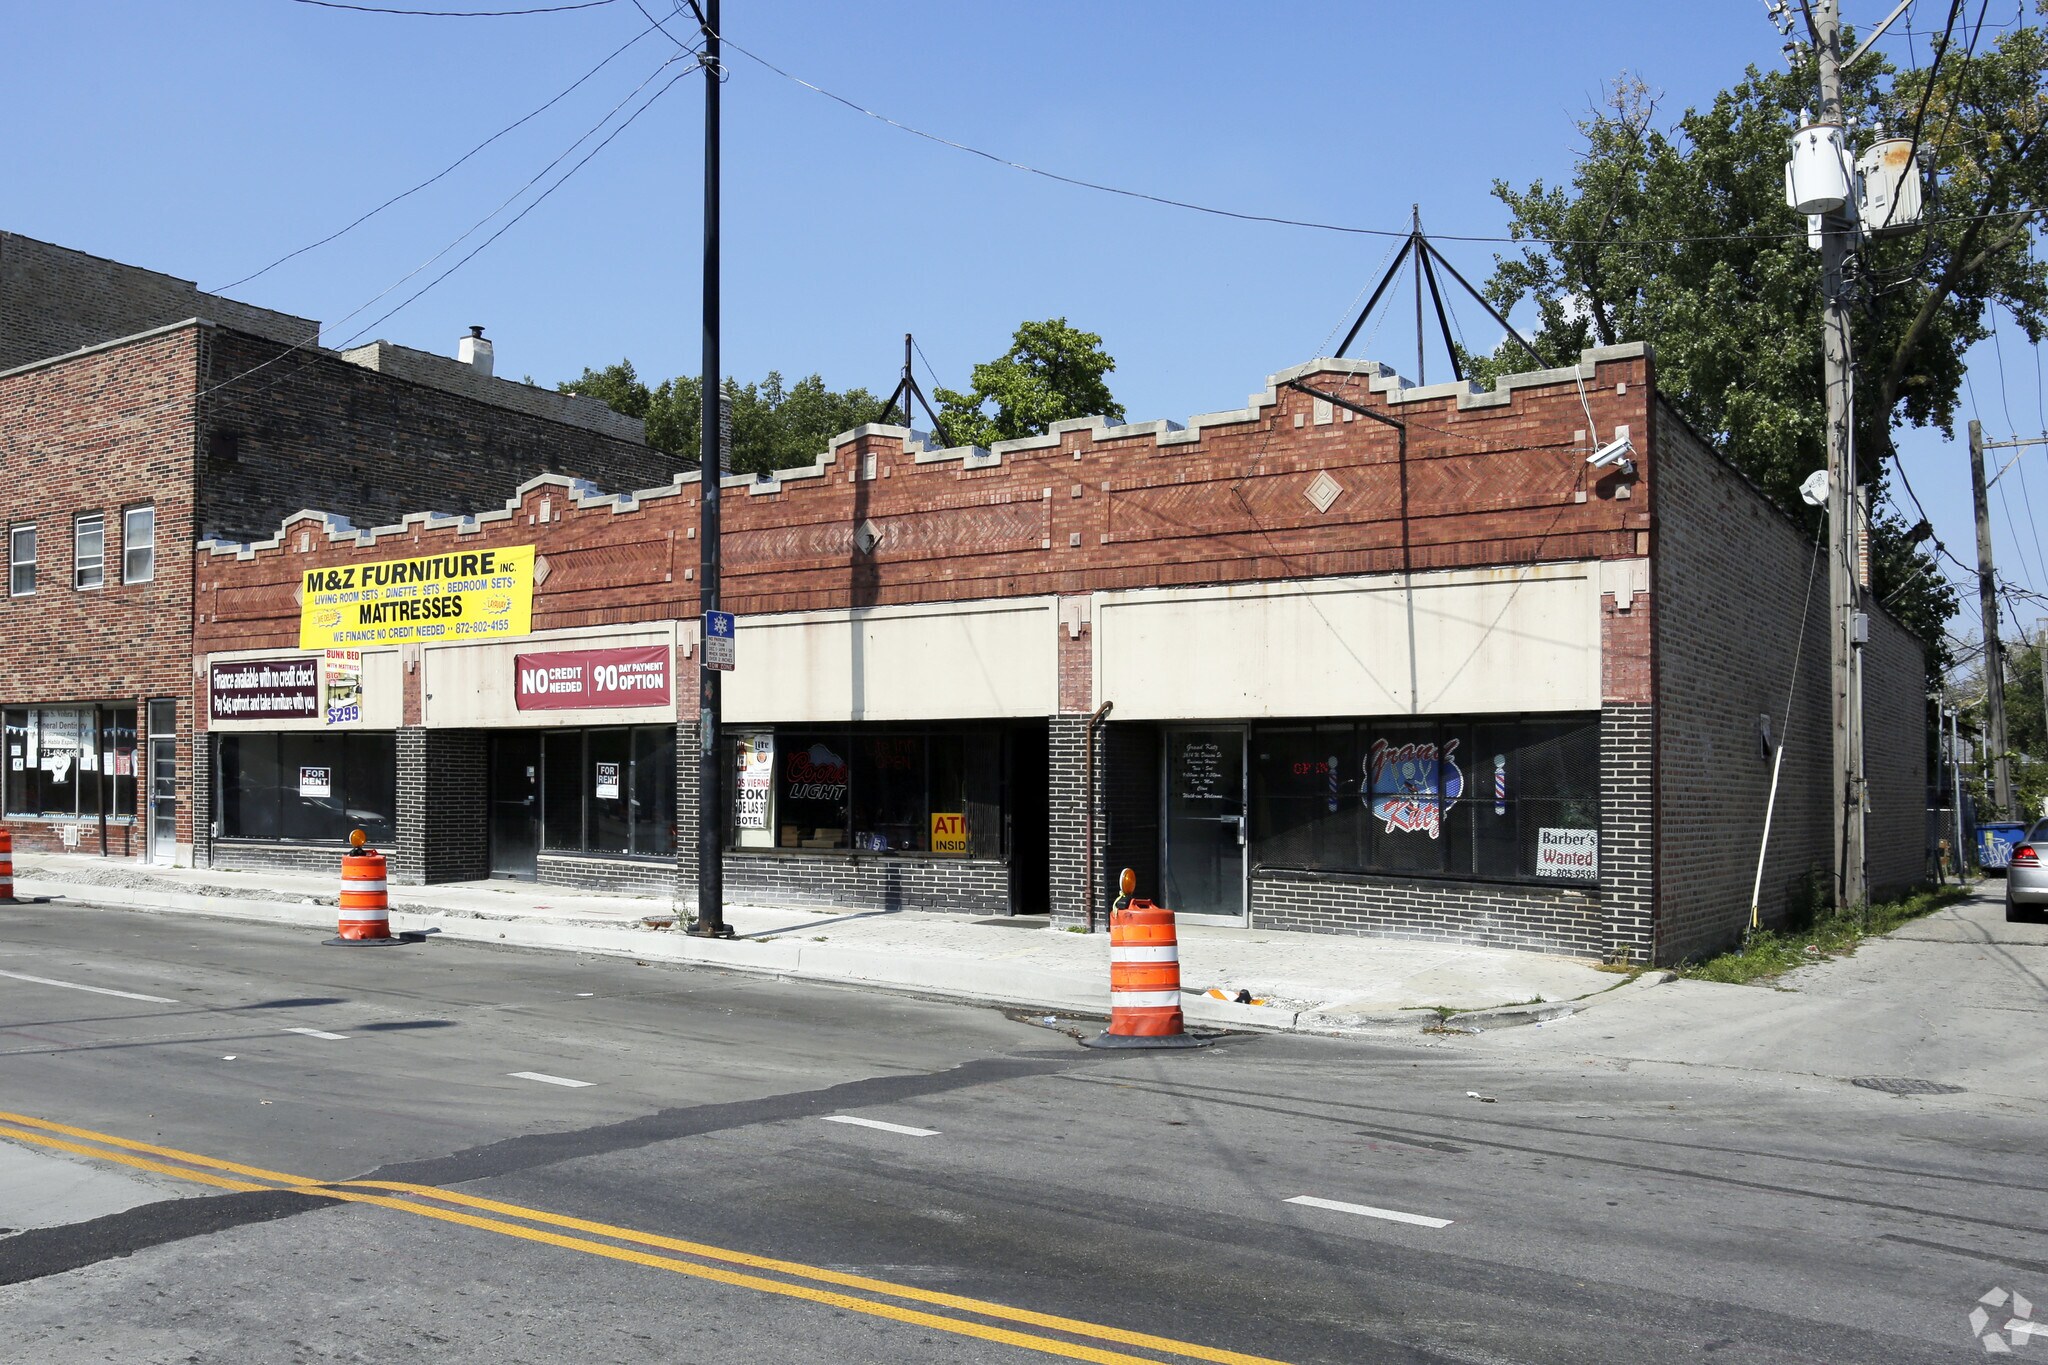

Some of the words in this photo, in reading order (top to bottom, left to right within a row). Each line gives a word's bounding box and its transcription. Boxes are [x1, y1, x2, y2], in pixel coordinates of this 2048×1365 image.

[307, 568, 355, 593] M&Z
[361, 552, 495, 587] FURNITURE
[500, 563, 517, 573] INC.
[315, 593, 338, 605] LIVING
[340, 591, 359, 603] ROOM
[361, 589, 379, 600] SETS
[386, 586, 417, 598] DINETTE
[423, 584, 439, 596] SETS
[447, 579, 487, 593] BEDROOM
[491, 577, 513, 589] SETS
[360, 595, 462, 625] MATTRESSES
[333, 632, 344, 642] WE
[345, 630, 375, 641] FINANCE
[377, 629, 386, 639] NO
[388, 626, 414, 639] CREDIT
[416, 624, 445, 637] NEEDED
[455, 619, 509, 634] 872-802-4155
[326, 649, 345, 659] BUNK
[346, 651, 360, 660] BED
[213, 668, 234, 689] Finance
[234, 667, 259, 689] available
[259, 666, 271, 688] with
[271, 671, 279, 687] no
[280, 665, 296, 687] credit
[296, 664, 315, 687] check
[521, 668, 549, 694] NO
[549, 666, 582, 680] CREDIT
[593, 665, 618, 692] 90
[618, 663, 632, 673] DAY
[632, 662, 664, 672] PAYMENT
[619, 673, 664, 690] OPTION
[549, 681, 582, 694] NEEDED
[214, 694, 222, 716] Pay
[232, 693, 250, 716] upfront
[250, 693, 259, 711] and
[260, 693, 271, 710] take
[271, 692, 293, 710] furniture
[292, 692, 304, 710] with
[304, 696, 315, 715] you
[328, 705, 359, 724] $299
[34, 721, 57, 729] Gneral
[59, 721, 88, 730] Dentisry
[755, 741, 769, 751] Lite
[1186, 743, 1203, 751] Grand
[305, 769, 325, 778] FOR
[600, 766, 615, 775] FOR
[787, 752, 849, 784] Coors
[302, 777, 328, 785] RENT
[598, 775, 617, 785] RENT
[747, 778, 769, 788] VIERNE
[738, 788, 768, 800] EOK
[789, 783, 847, 800] LIGHT
[748, 801, 758, 814] LAS
[737, 816, 763, 825] BOTEL
[1542, 831, 1596, 846] Barber's
[936, 840, 966, 851] INSID
[1543, 849, 1593, 866] Wanted
[1537, 868, 1597, 880] 773-905-9593
